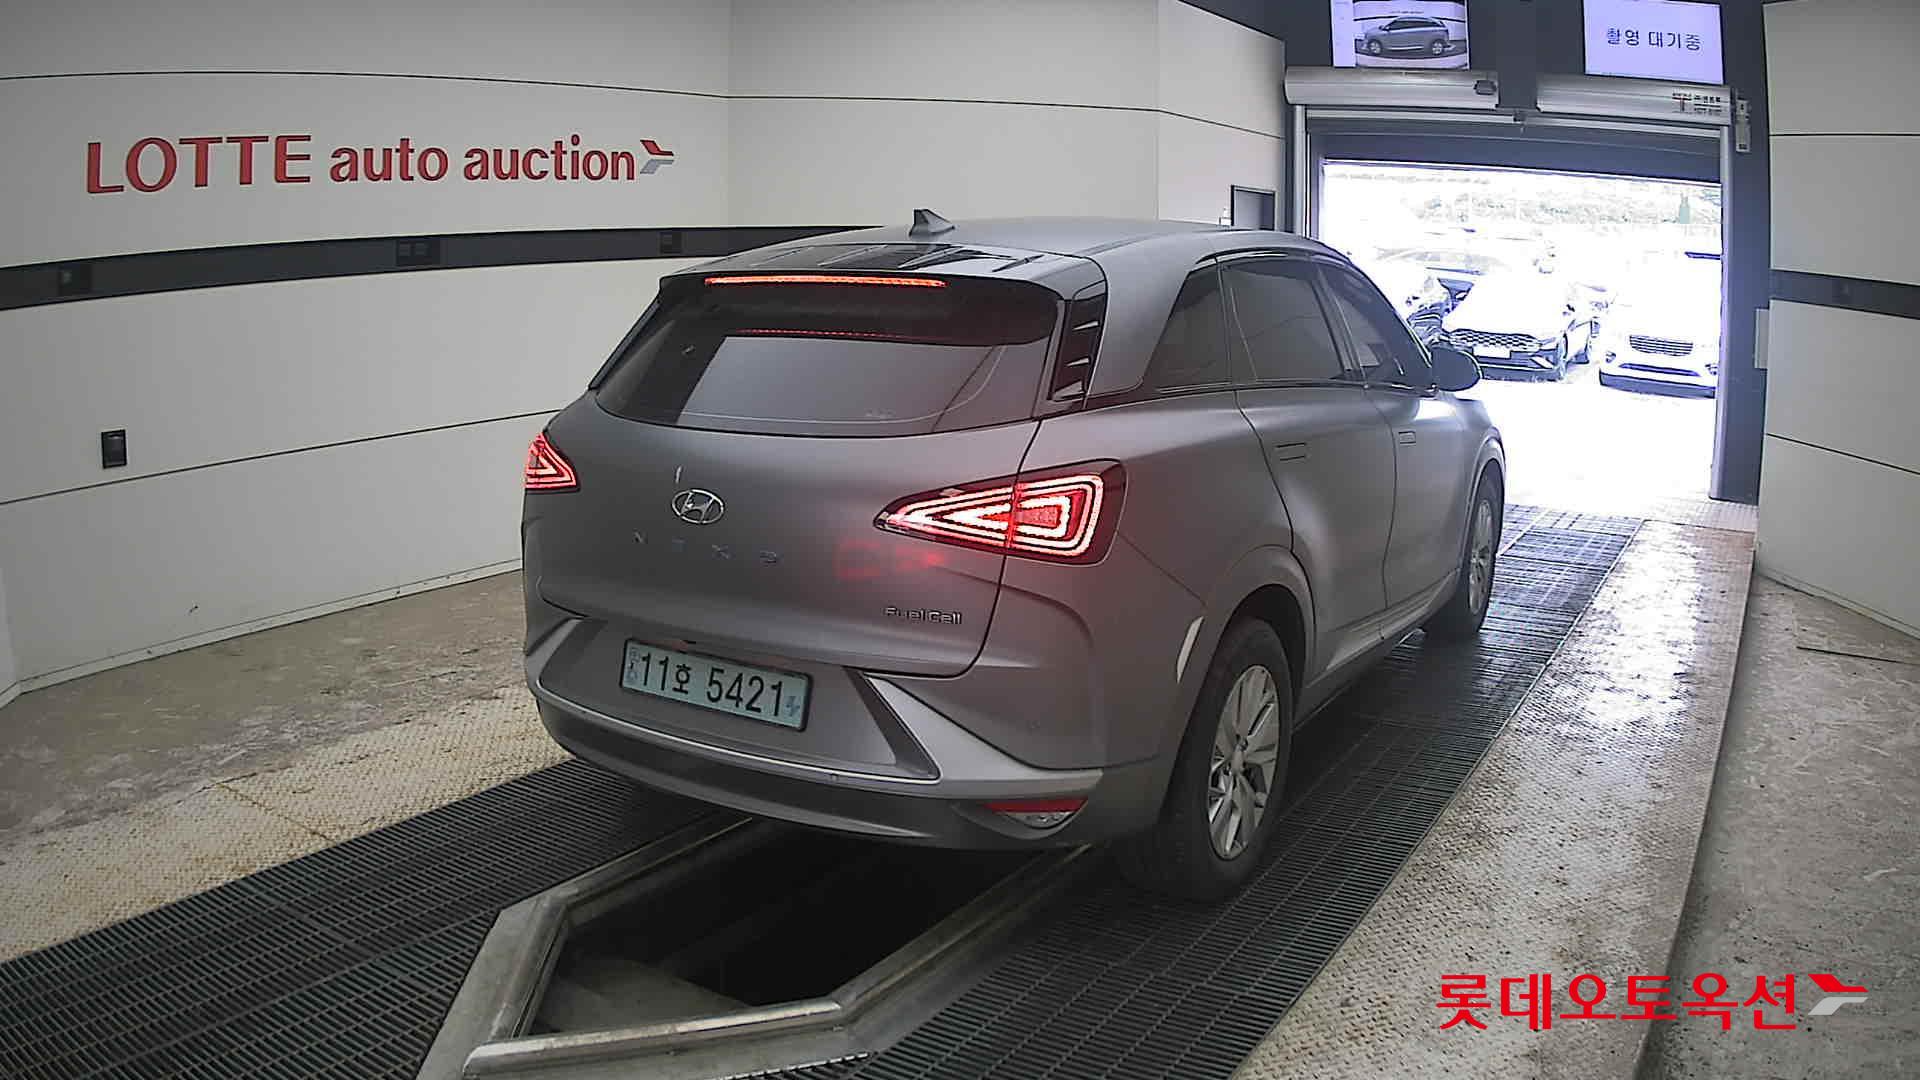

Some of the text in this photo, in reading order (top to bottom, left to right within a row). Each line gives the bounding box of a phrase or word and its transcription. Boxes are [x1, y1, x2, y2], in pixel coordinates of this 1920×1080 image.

[1648, 32, 1701, 51] 대기중
[87, 134, 635, 193] LOTTE auto auction
[641, 653, 782, 717] 11호 5421
